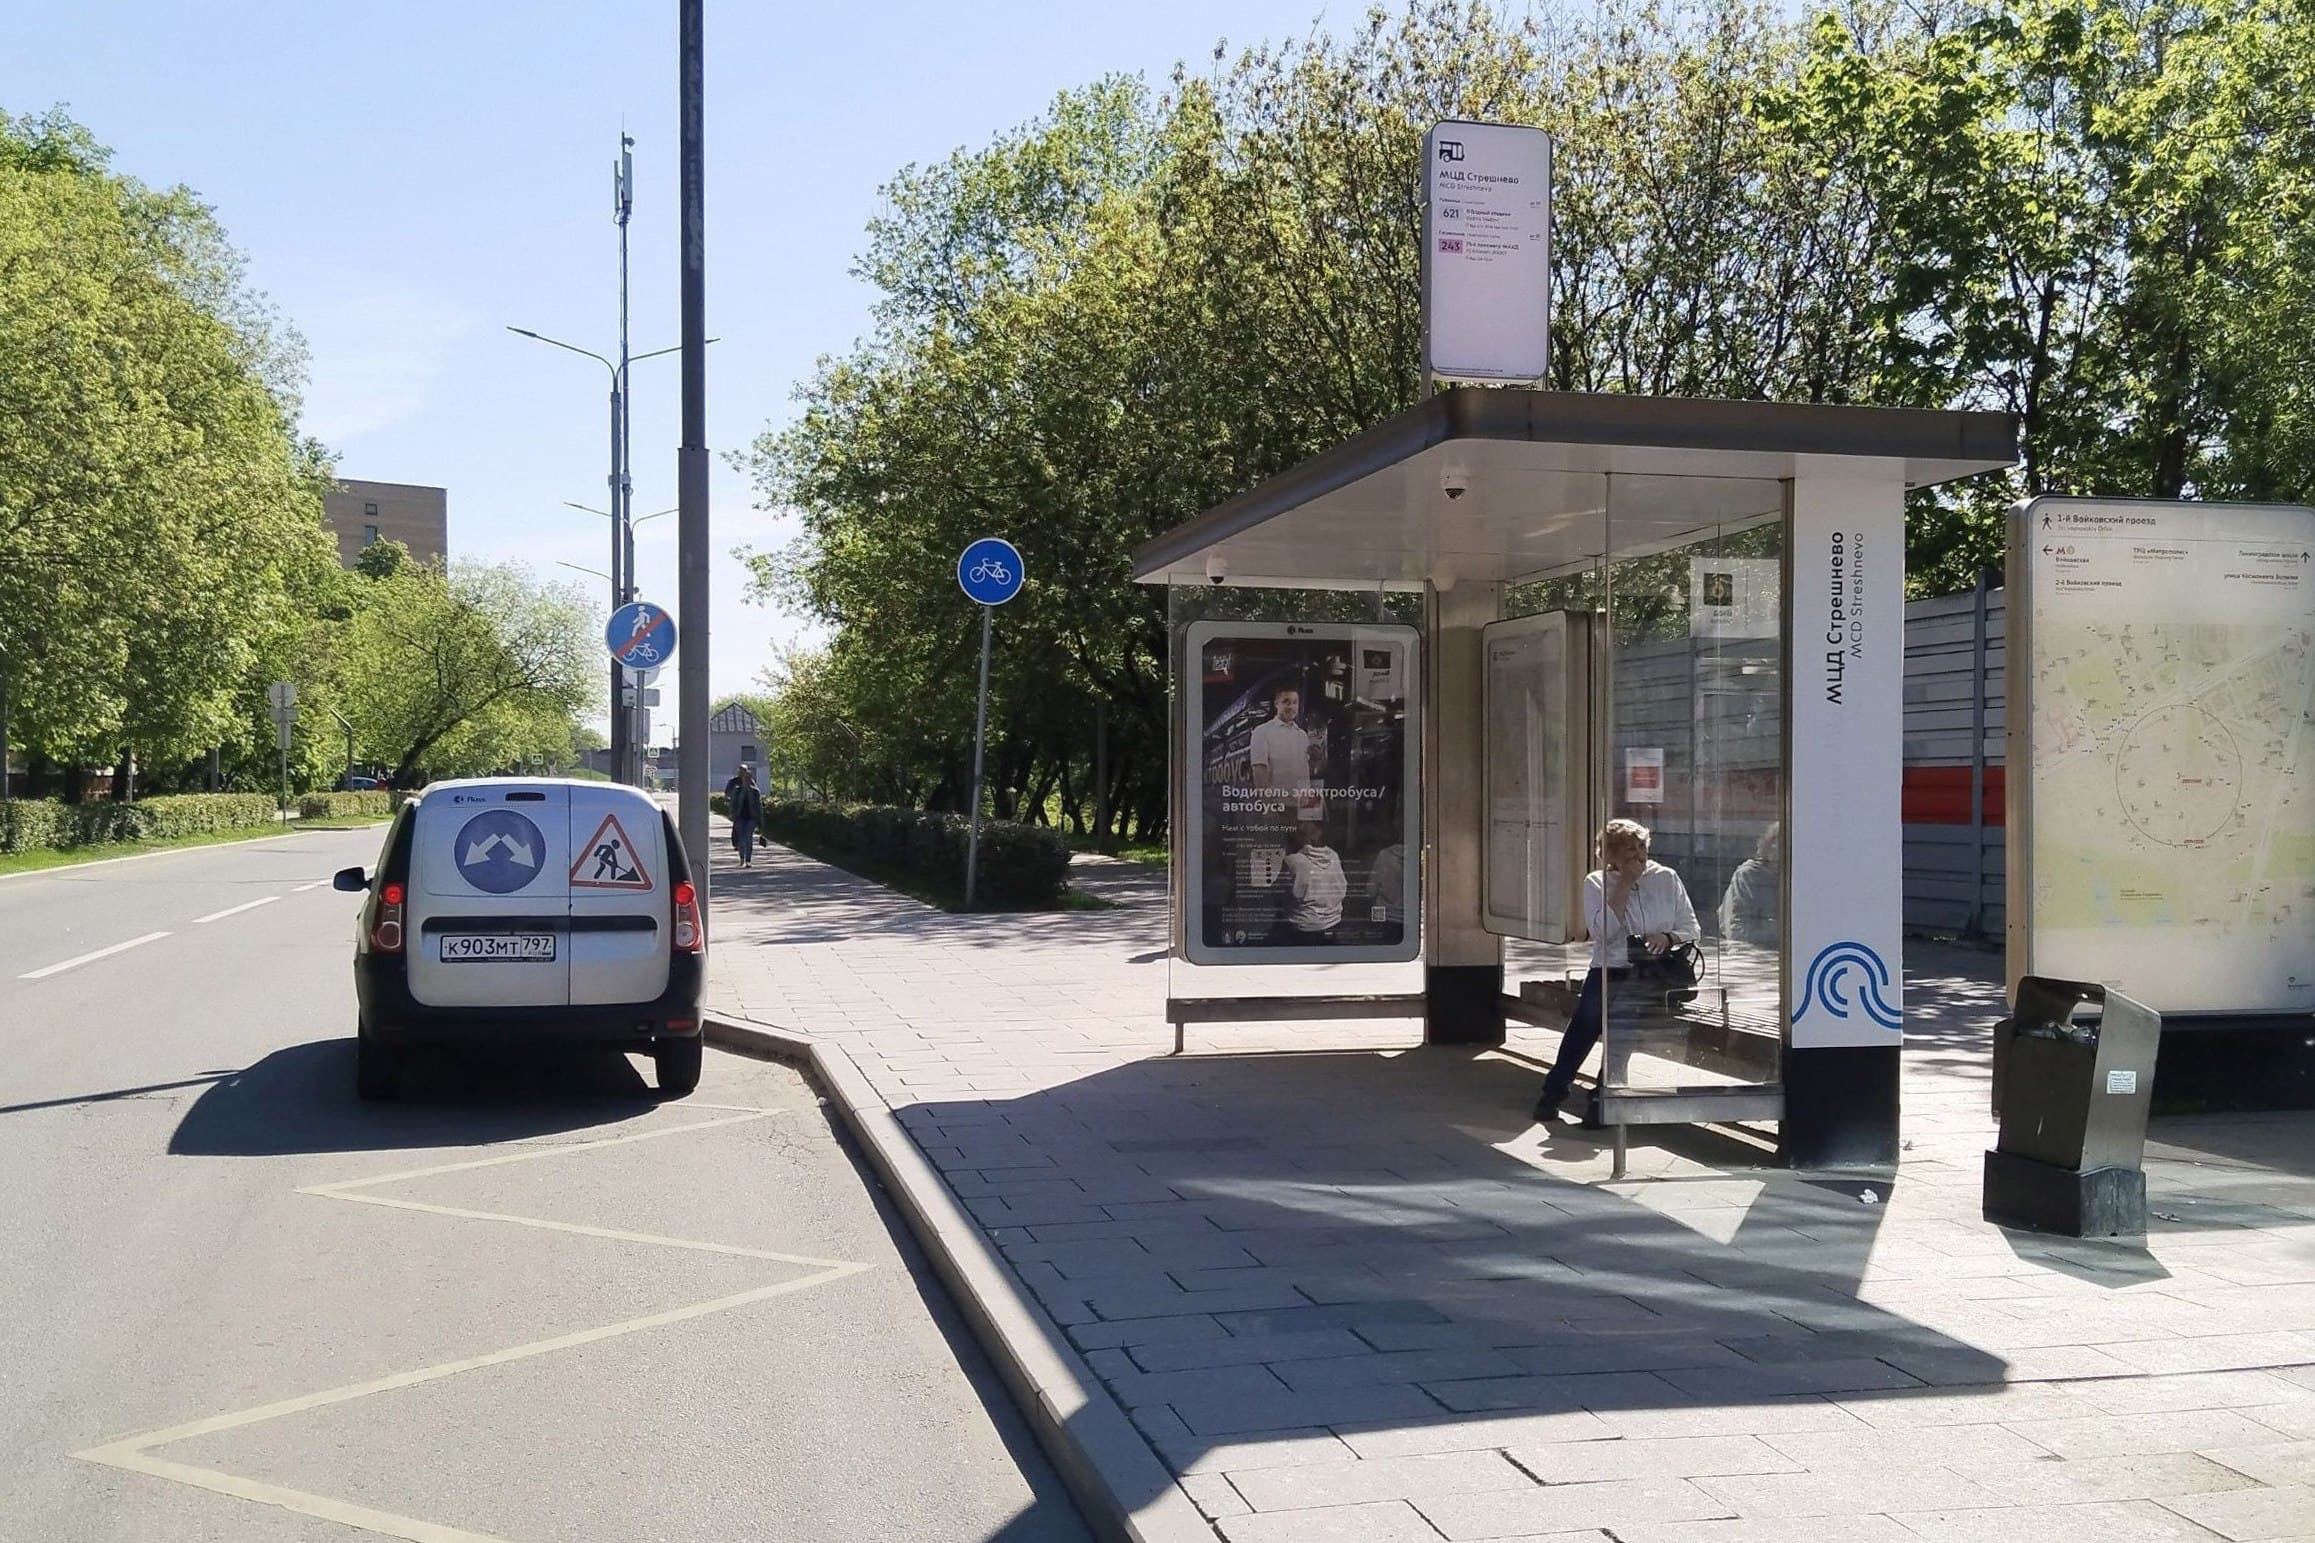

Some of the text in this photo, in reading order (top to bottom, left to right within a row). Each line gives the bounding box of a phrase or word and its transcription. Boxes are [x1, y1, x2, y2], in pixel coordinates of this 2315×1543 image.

[1439, 170, 1519, 184] МЦД Стрешнево
[1443, 208, 1459, 218] 621
[1441, 241, 1460, 251] 243
[2073, 514, 2124, 525] Войковский
[2125, 517, 2156, 526] проезд
[1851, 532, 1864, 659] MCD Streshnevo
[1827, 531, 1846, 705] МЦД Стрешнево
[1222, 785, 1289, 799] Водитель
[1222, 800, 1286, 815] автобуса
[448, 938, 550, 955] К903МТ 797
